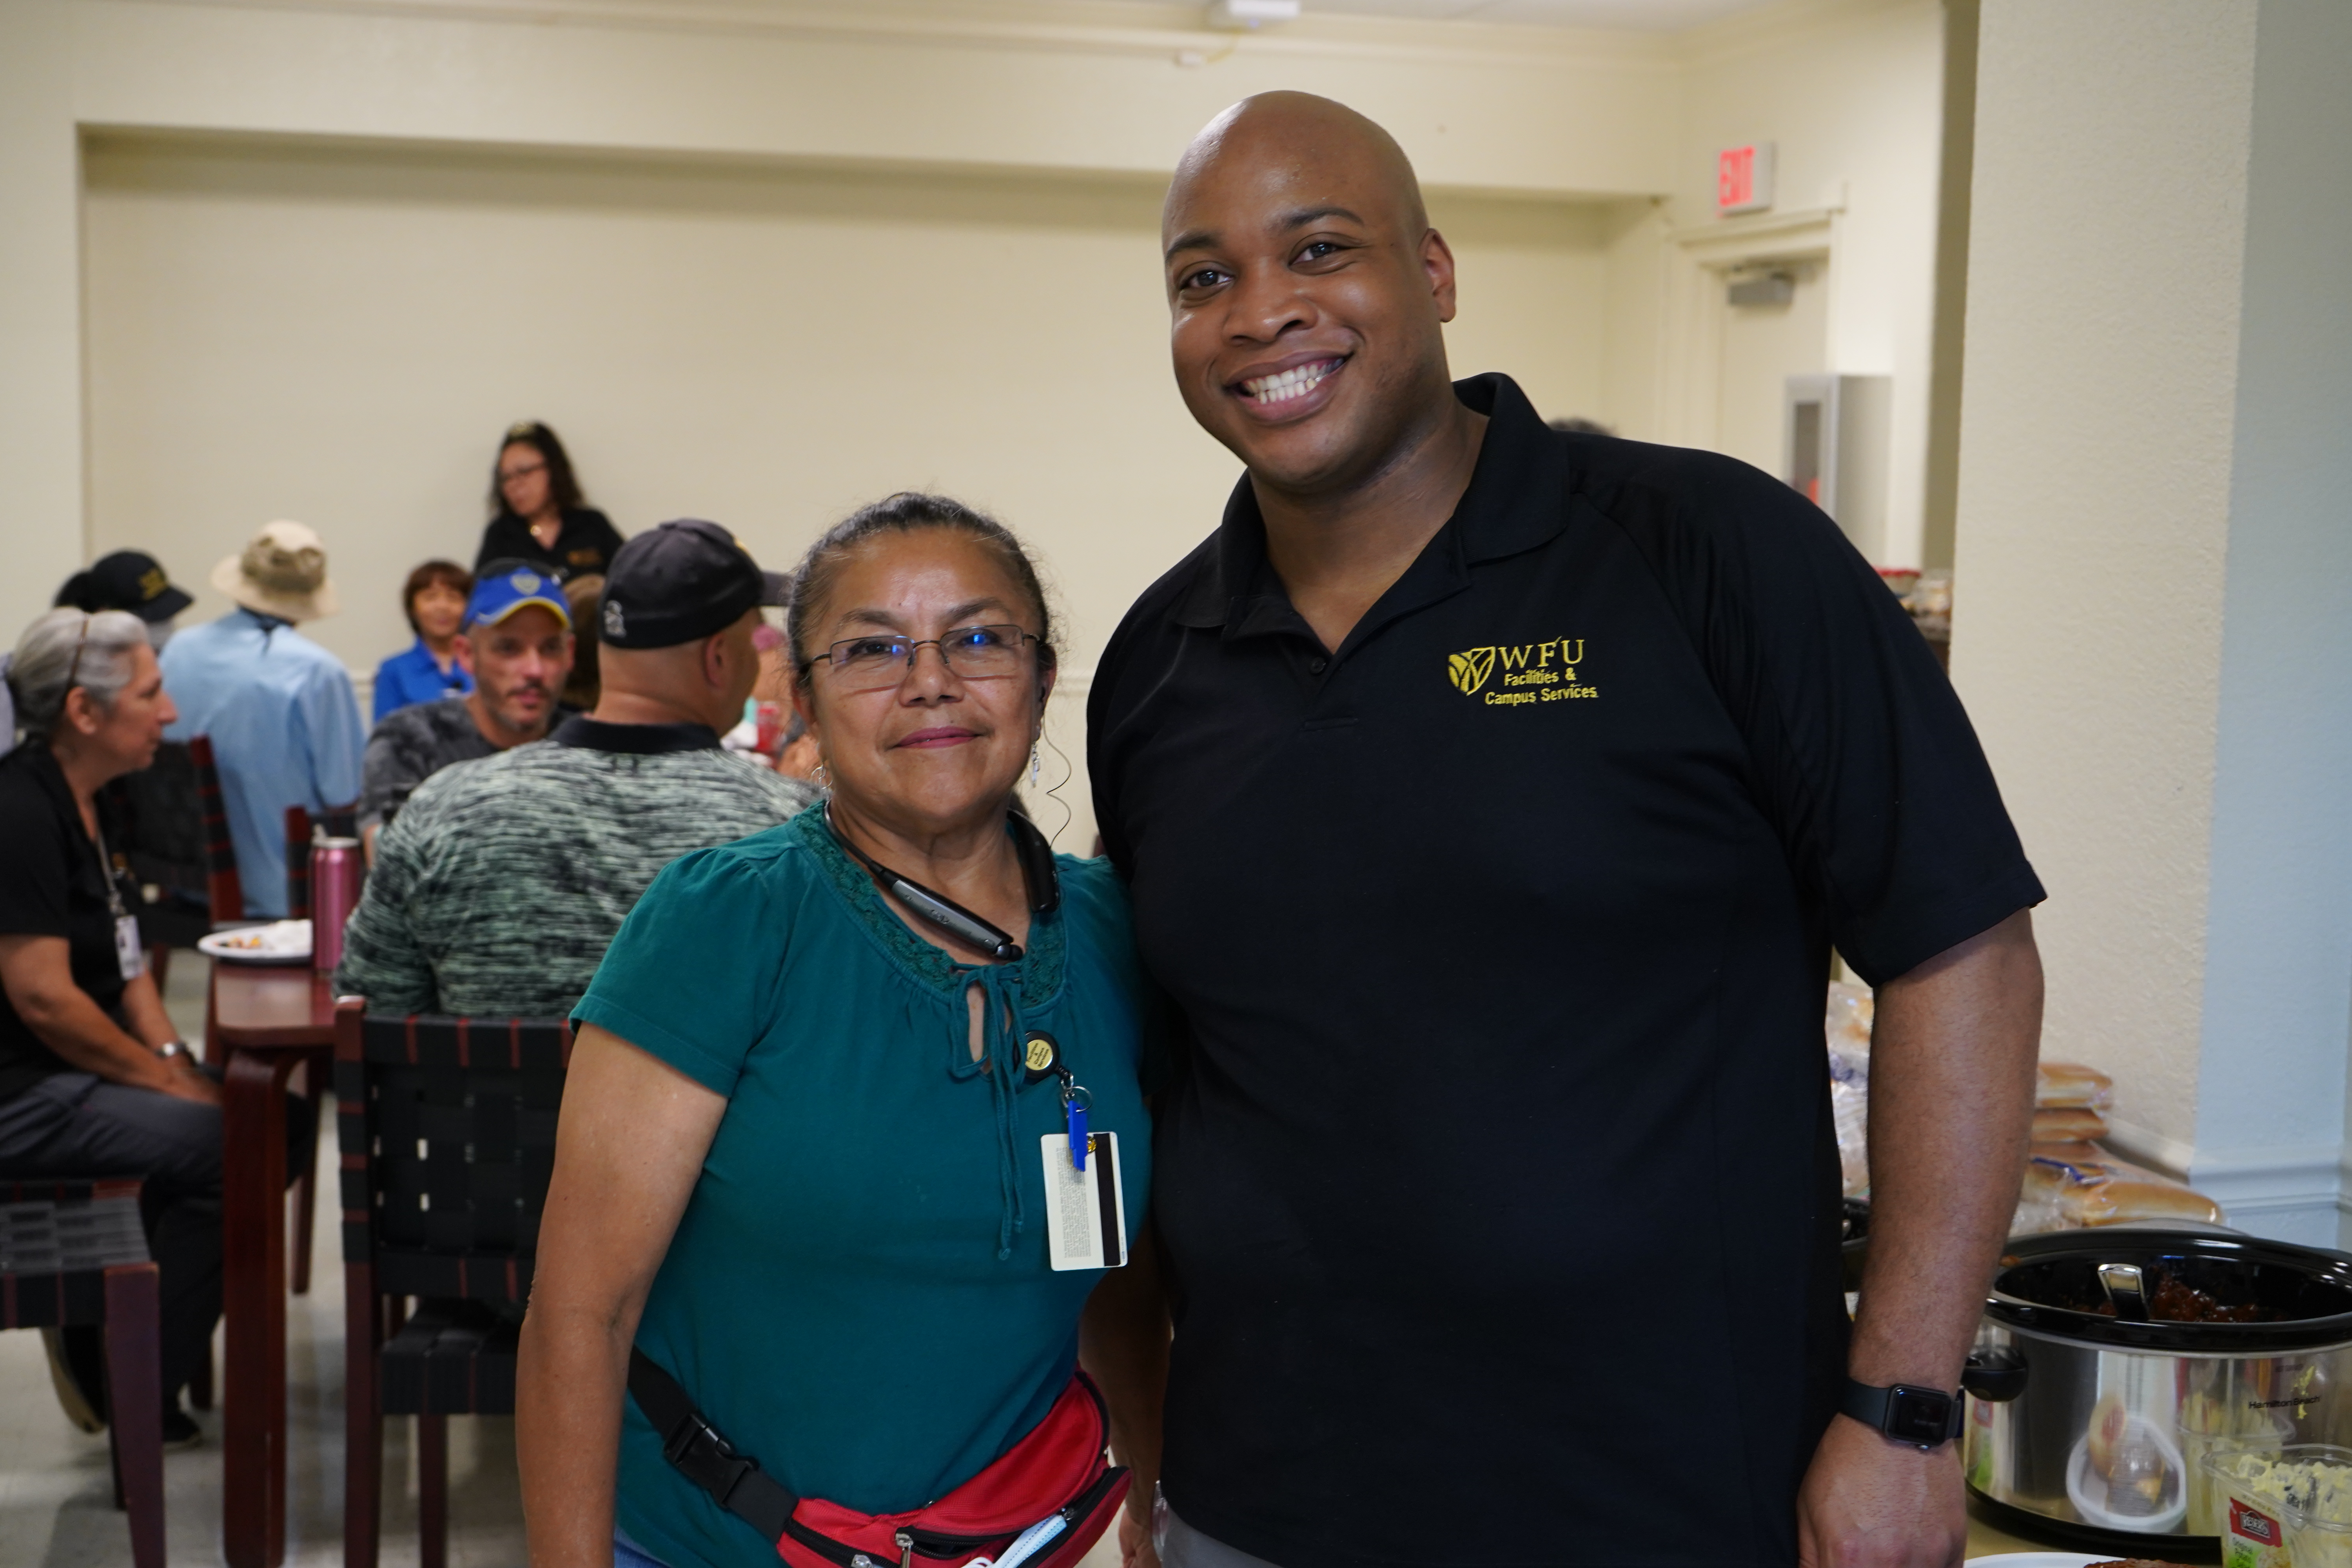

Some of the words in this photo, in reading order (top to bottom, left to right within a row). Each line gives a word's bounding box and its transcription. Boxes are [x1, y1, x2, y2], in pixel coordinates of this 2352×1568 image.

[1719, 146, 1754, 206] EXIT
[1498, 639, 1584, 670] WFU
[1504, 669, 1559, 686] Facilities
[1565, 667, 1577, 681] &
[1485, 691, 1536, 706] Campus
[1541, 684, 1599, 701] Services
[2248, 1400, 2293, 1409] Hamilton
[2294, 1396, 2320, 1405] Beach
